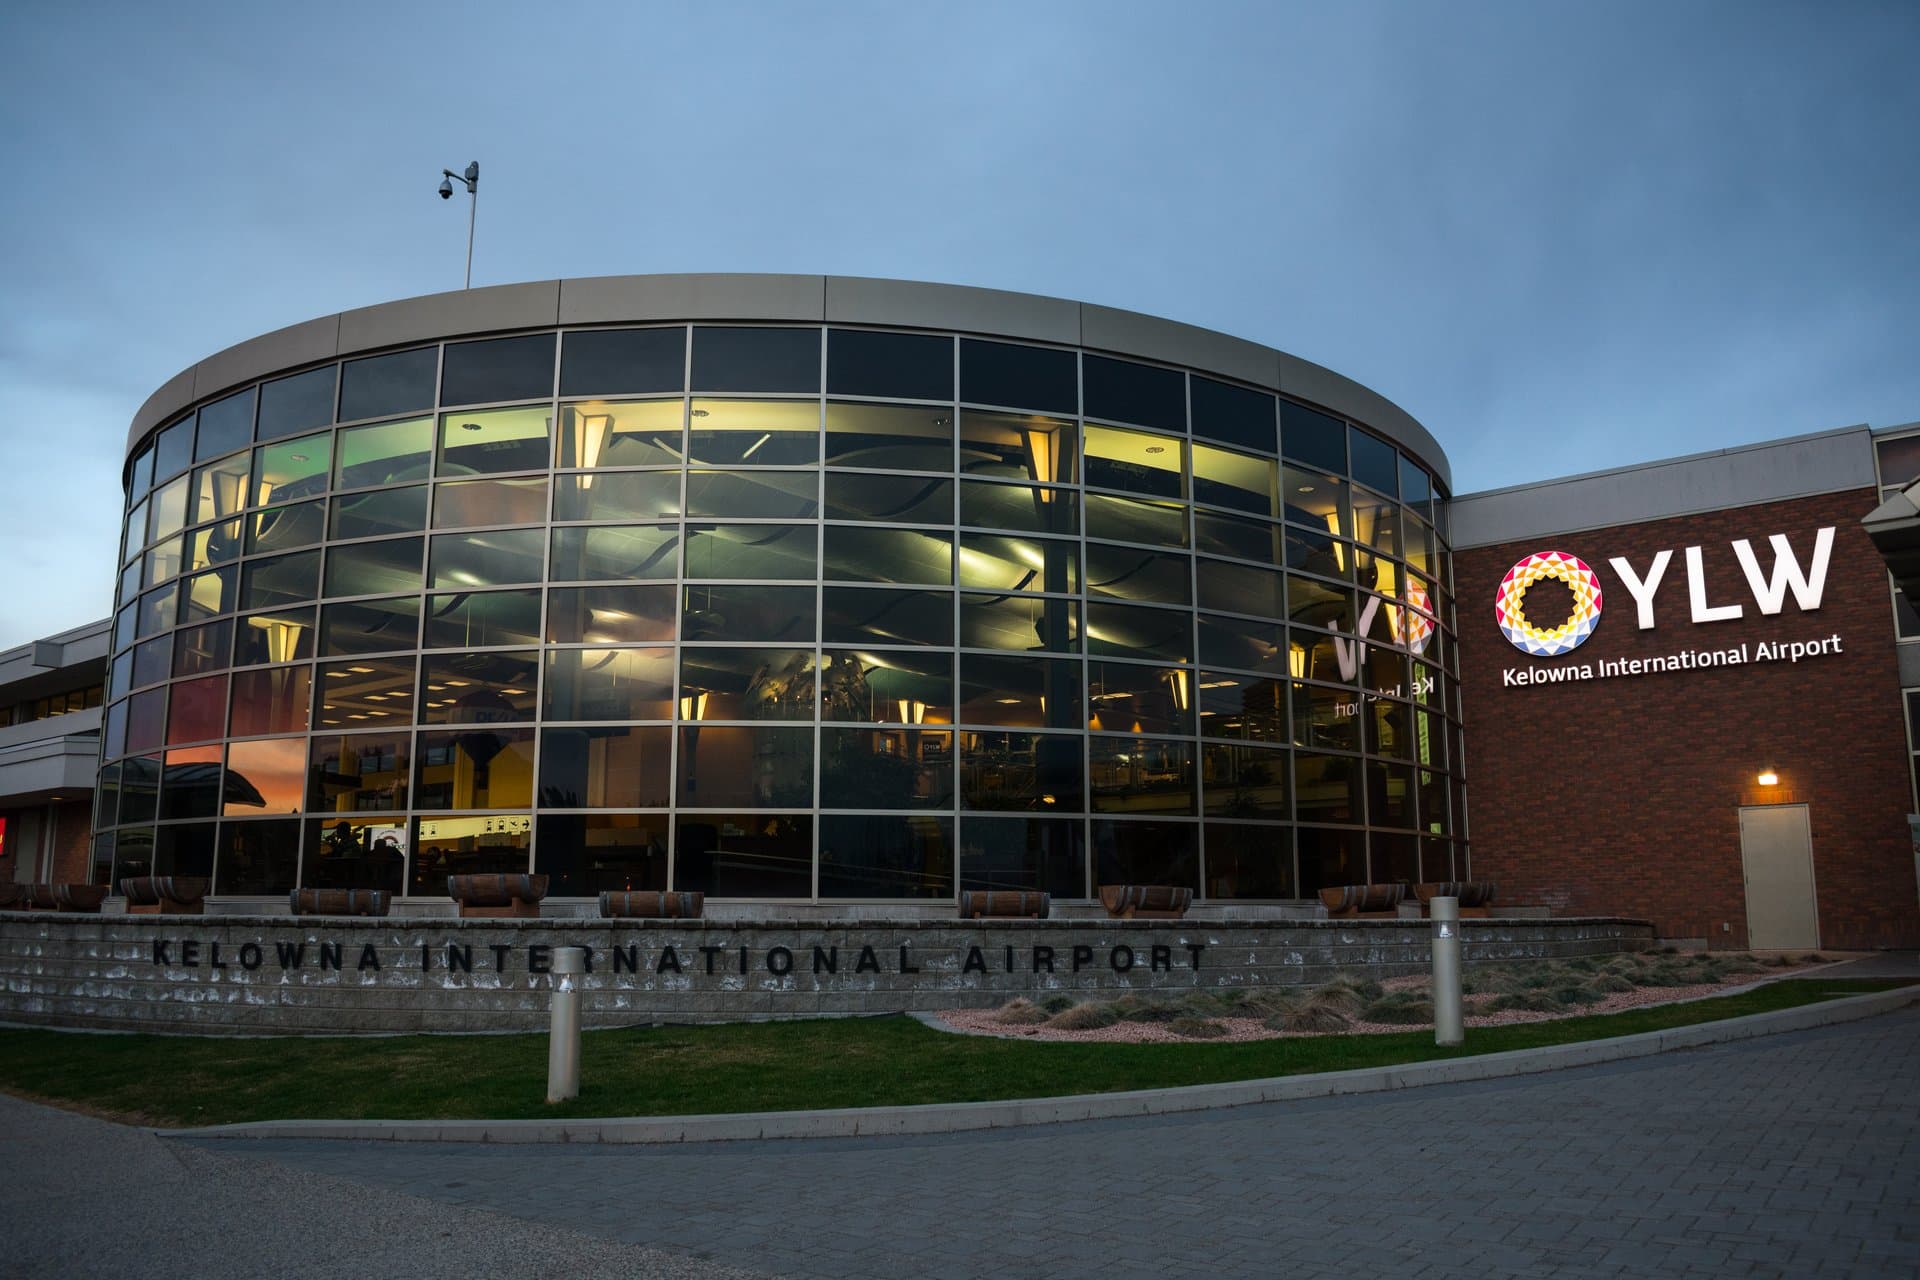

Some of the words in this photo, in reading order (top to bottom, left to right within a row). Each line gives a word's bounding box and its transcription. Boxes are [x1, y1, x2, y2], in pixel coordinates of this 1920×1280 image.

[1608, 526, 1837, 630] YLW
[1502, 662, 1594, 687] Kelowna
[1598, 643, 1749, 678] International
[1754, 633, 1844, 663] Airport
[152, 939, 382, 972] KELOWNA
[962, 944, 1206, 974] AIRPORT
